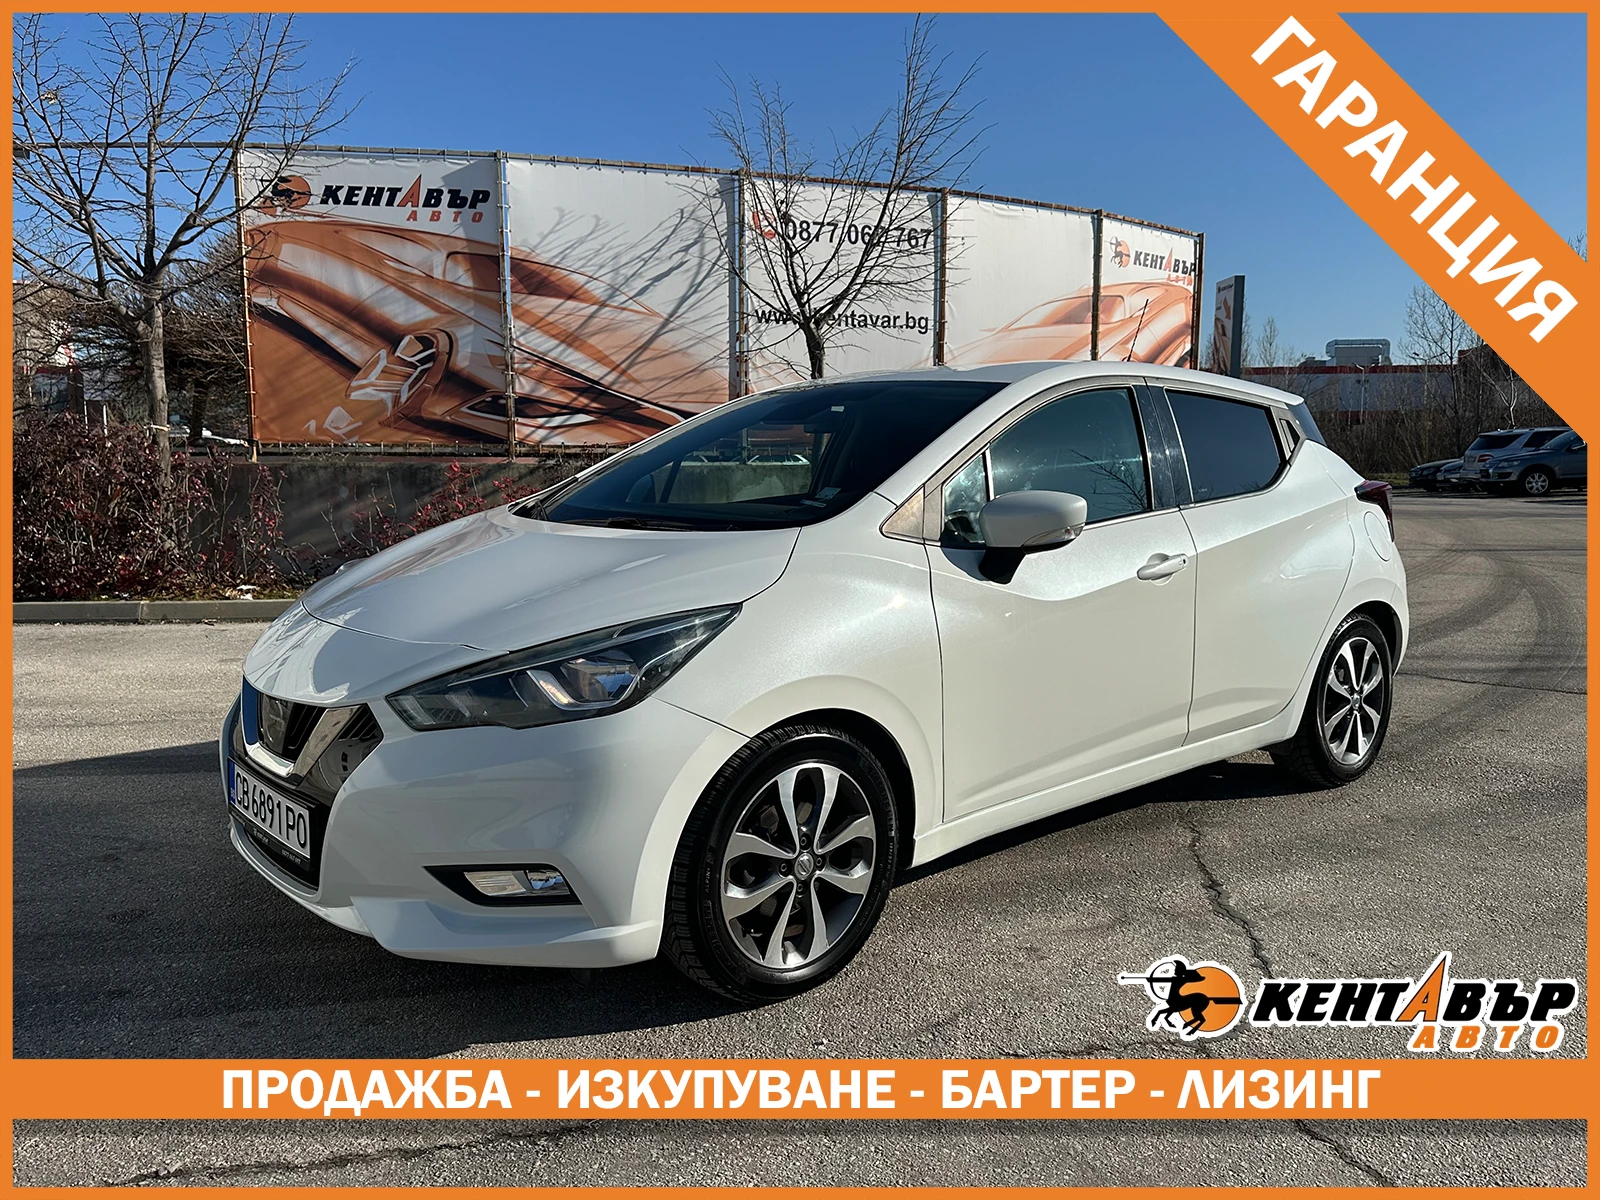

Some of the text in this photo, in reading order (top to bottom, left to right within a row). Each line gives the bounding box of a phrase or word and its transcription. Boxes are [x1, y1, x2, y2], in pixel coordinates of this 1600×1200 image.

[319, 174, 491, 210] КЕНТАВЪР
[406, 210, 484, 223] АВТО
[1133, 247, 1196, 276] КЕНТАВЪР
